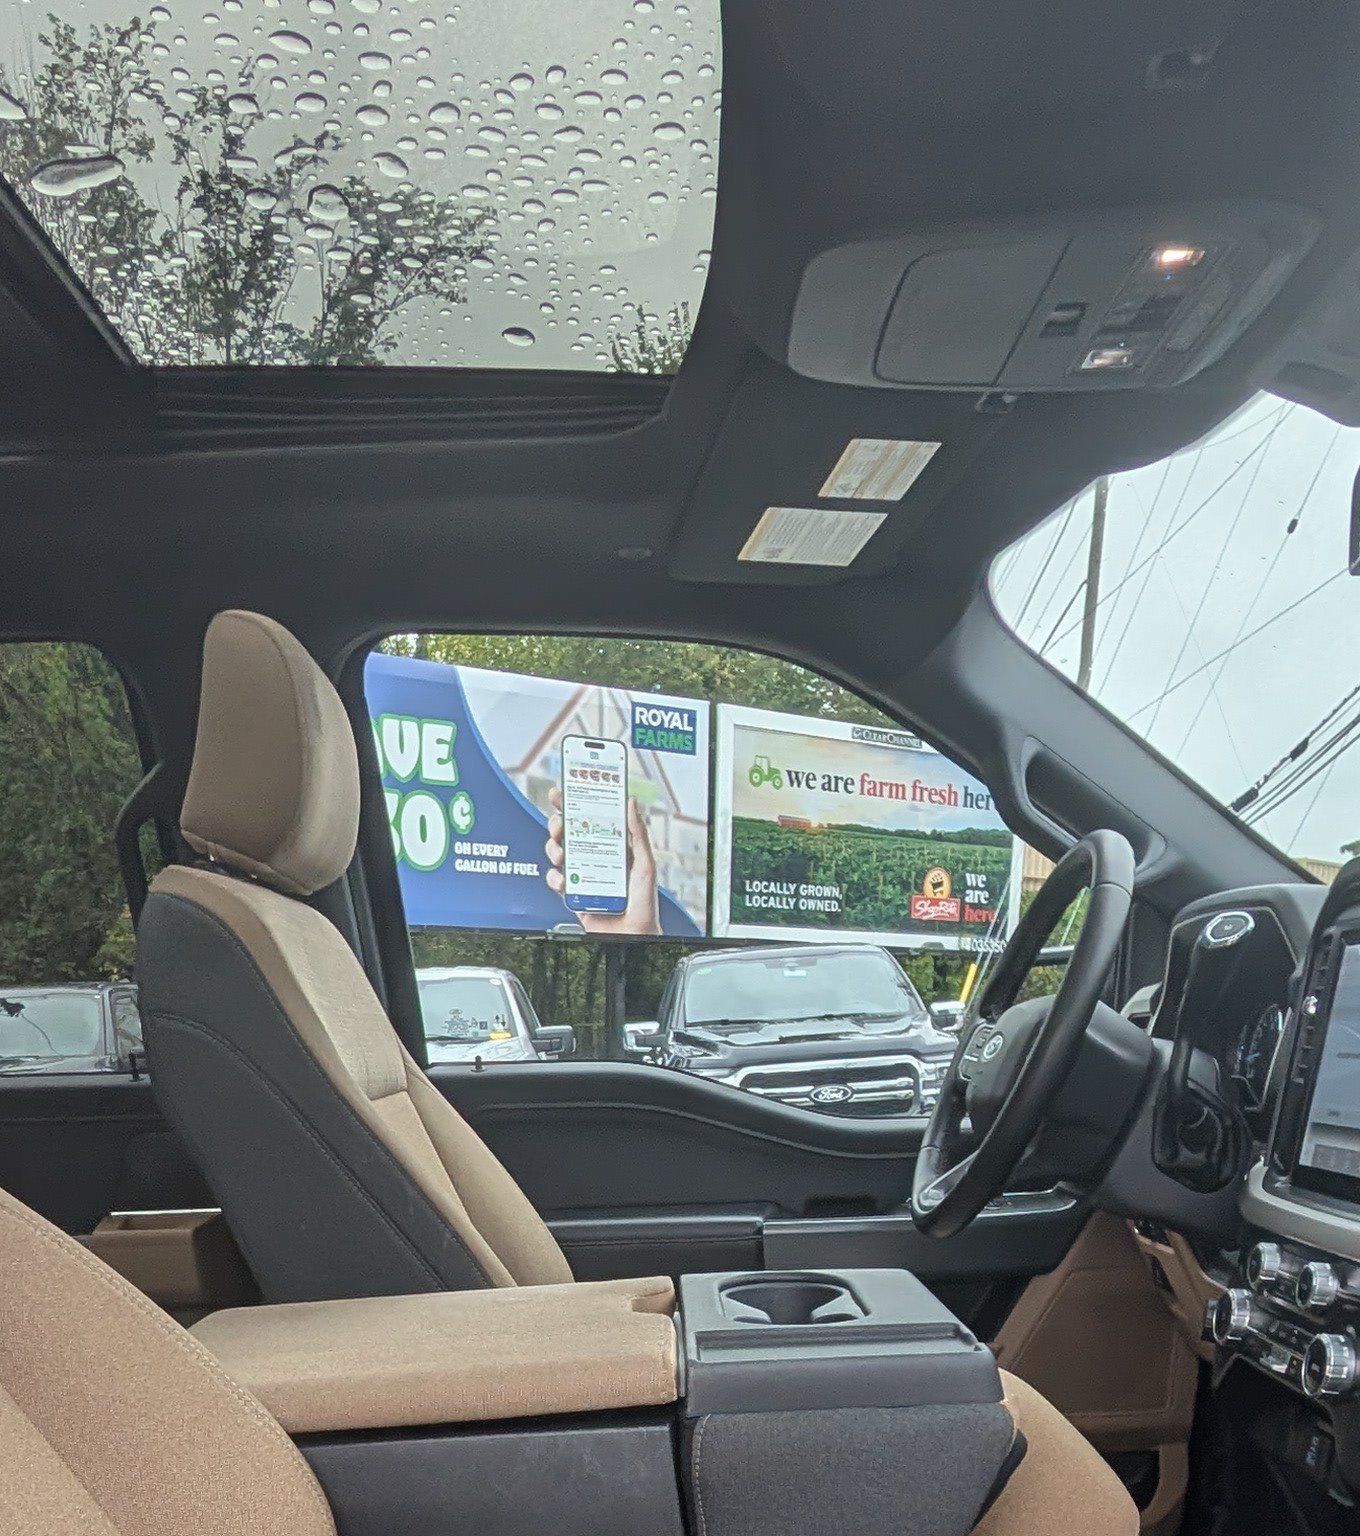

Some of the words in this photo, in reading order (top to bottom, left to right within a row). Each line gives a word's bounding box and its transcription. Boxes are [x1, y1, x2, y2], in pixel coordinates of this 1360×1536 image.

[635, 706, 693, 732] ROYAL
[635, 727, 693, 751] FARMS
[372, 715, 458, 784] VE
[785, 769, 817, 790] we
[821, 774, 855, 795] are
[859, 772, 907, 801] farm
[911, 779, 958, 807] fresh
[961, 785, 991, 811] her
[454, 841, 471, 855] ON
[472, 842, 509, 858] EVERY
[455, 858, 498, 874] GALLON
[499, 861, 512, 875] OF
[513, 862, 540, 876] FUEL
[964, 872, 987, 888] we
[745, 880, 797, 895] LOCALLY
[800, 884, 843, 900] GROWN,
[964, 889, 990, 905] are
[745, 894, 797, 910] LOCALLY
[799, 898, 842, 912] OWNED.
[818, 1086, 844, 1100] Ford
